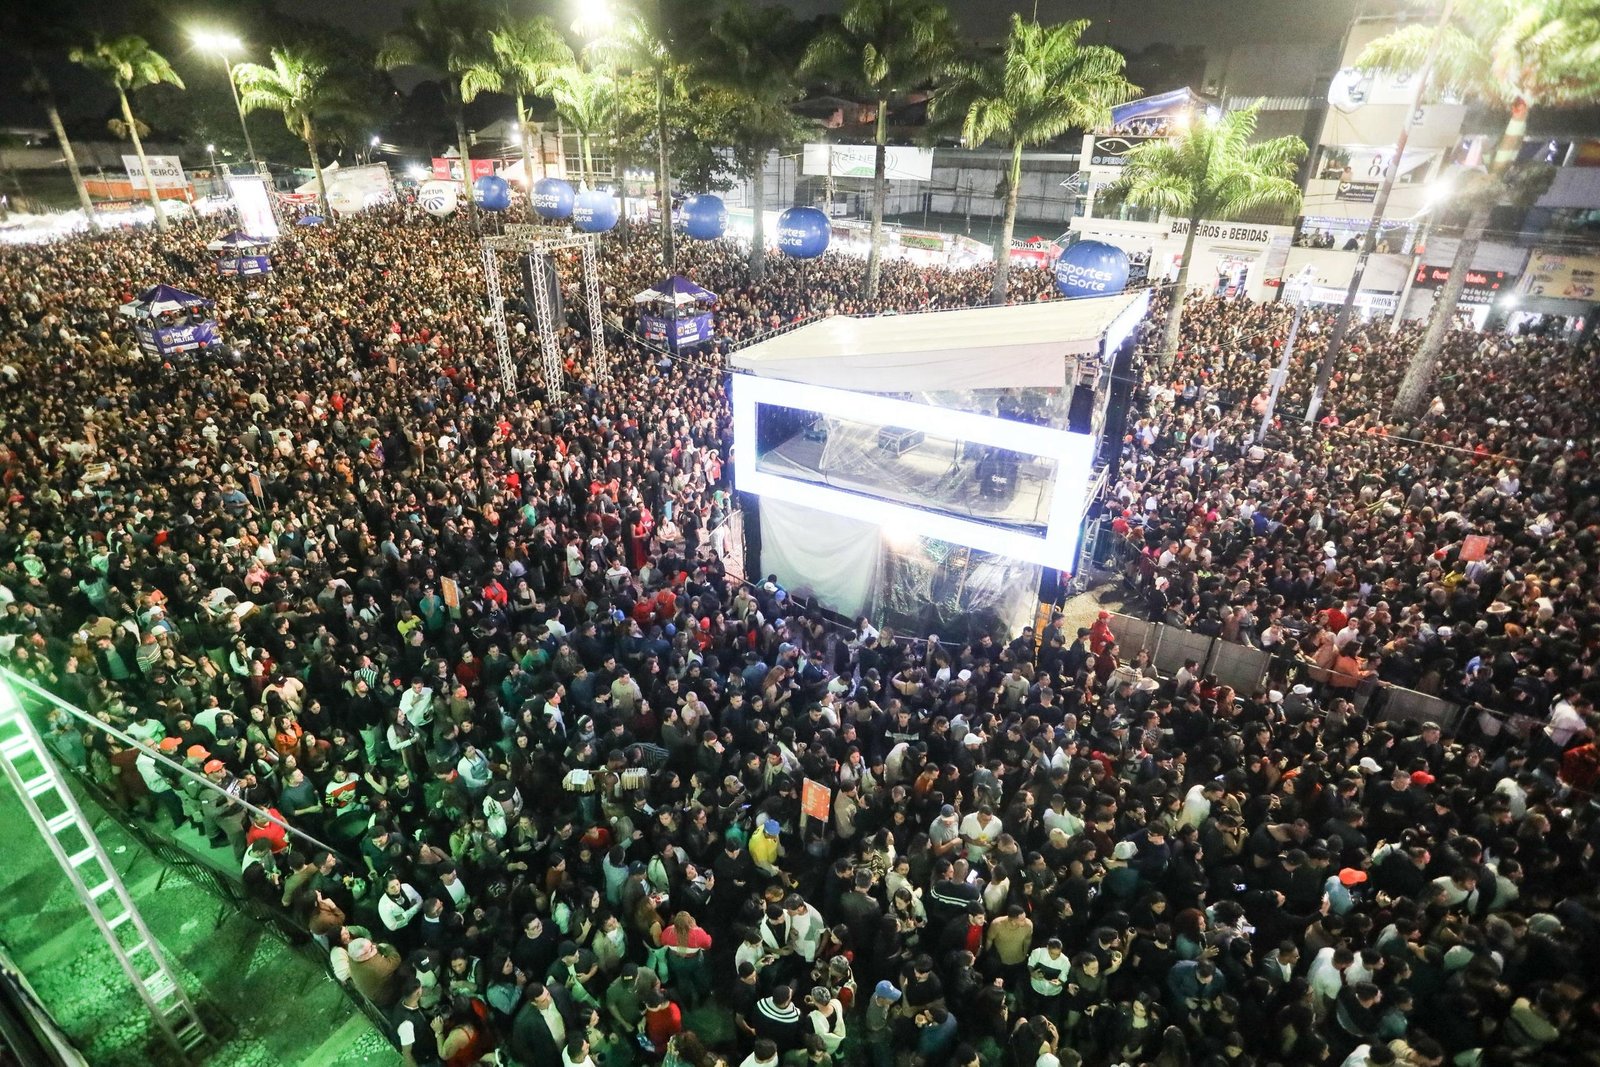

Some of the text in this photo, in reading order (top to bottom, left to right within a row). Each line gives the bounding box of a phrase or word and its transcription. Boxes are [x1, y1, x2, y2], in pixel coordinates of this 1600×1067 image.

[1171, 221, 1269, 243] BANEIROS e BEBIDAS
[1068, 275, 1106, 291] Sorte
